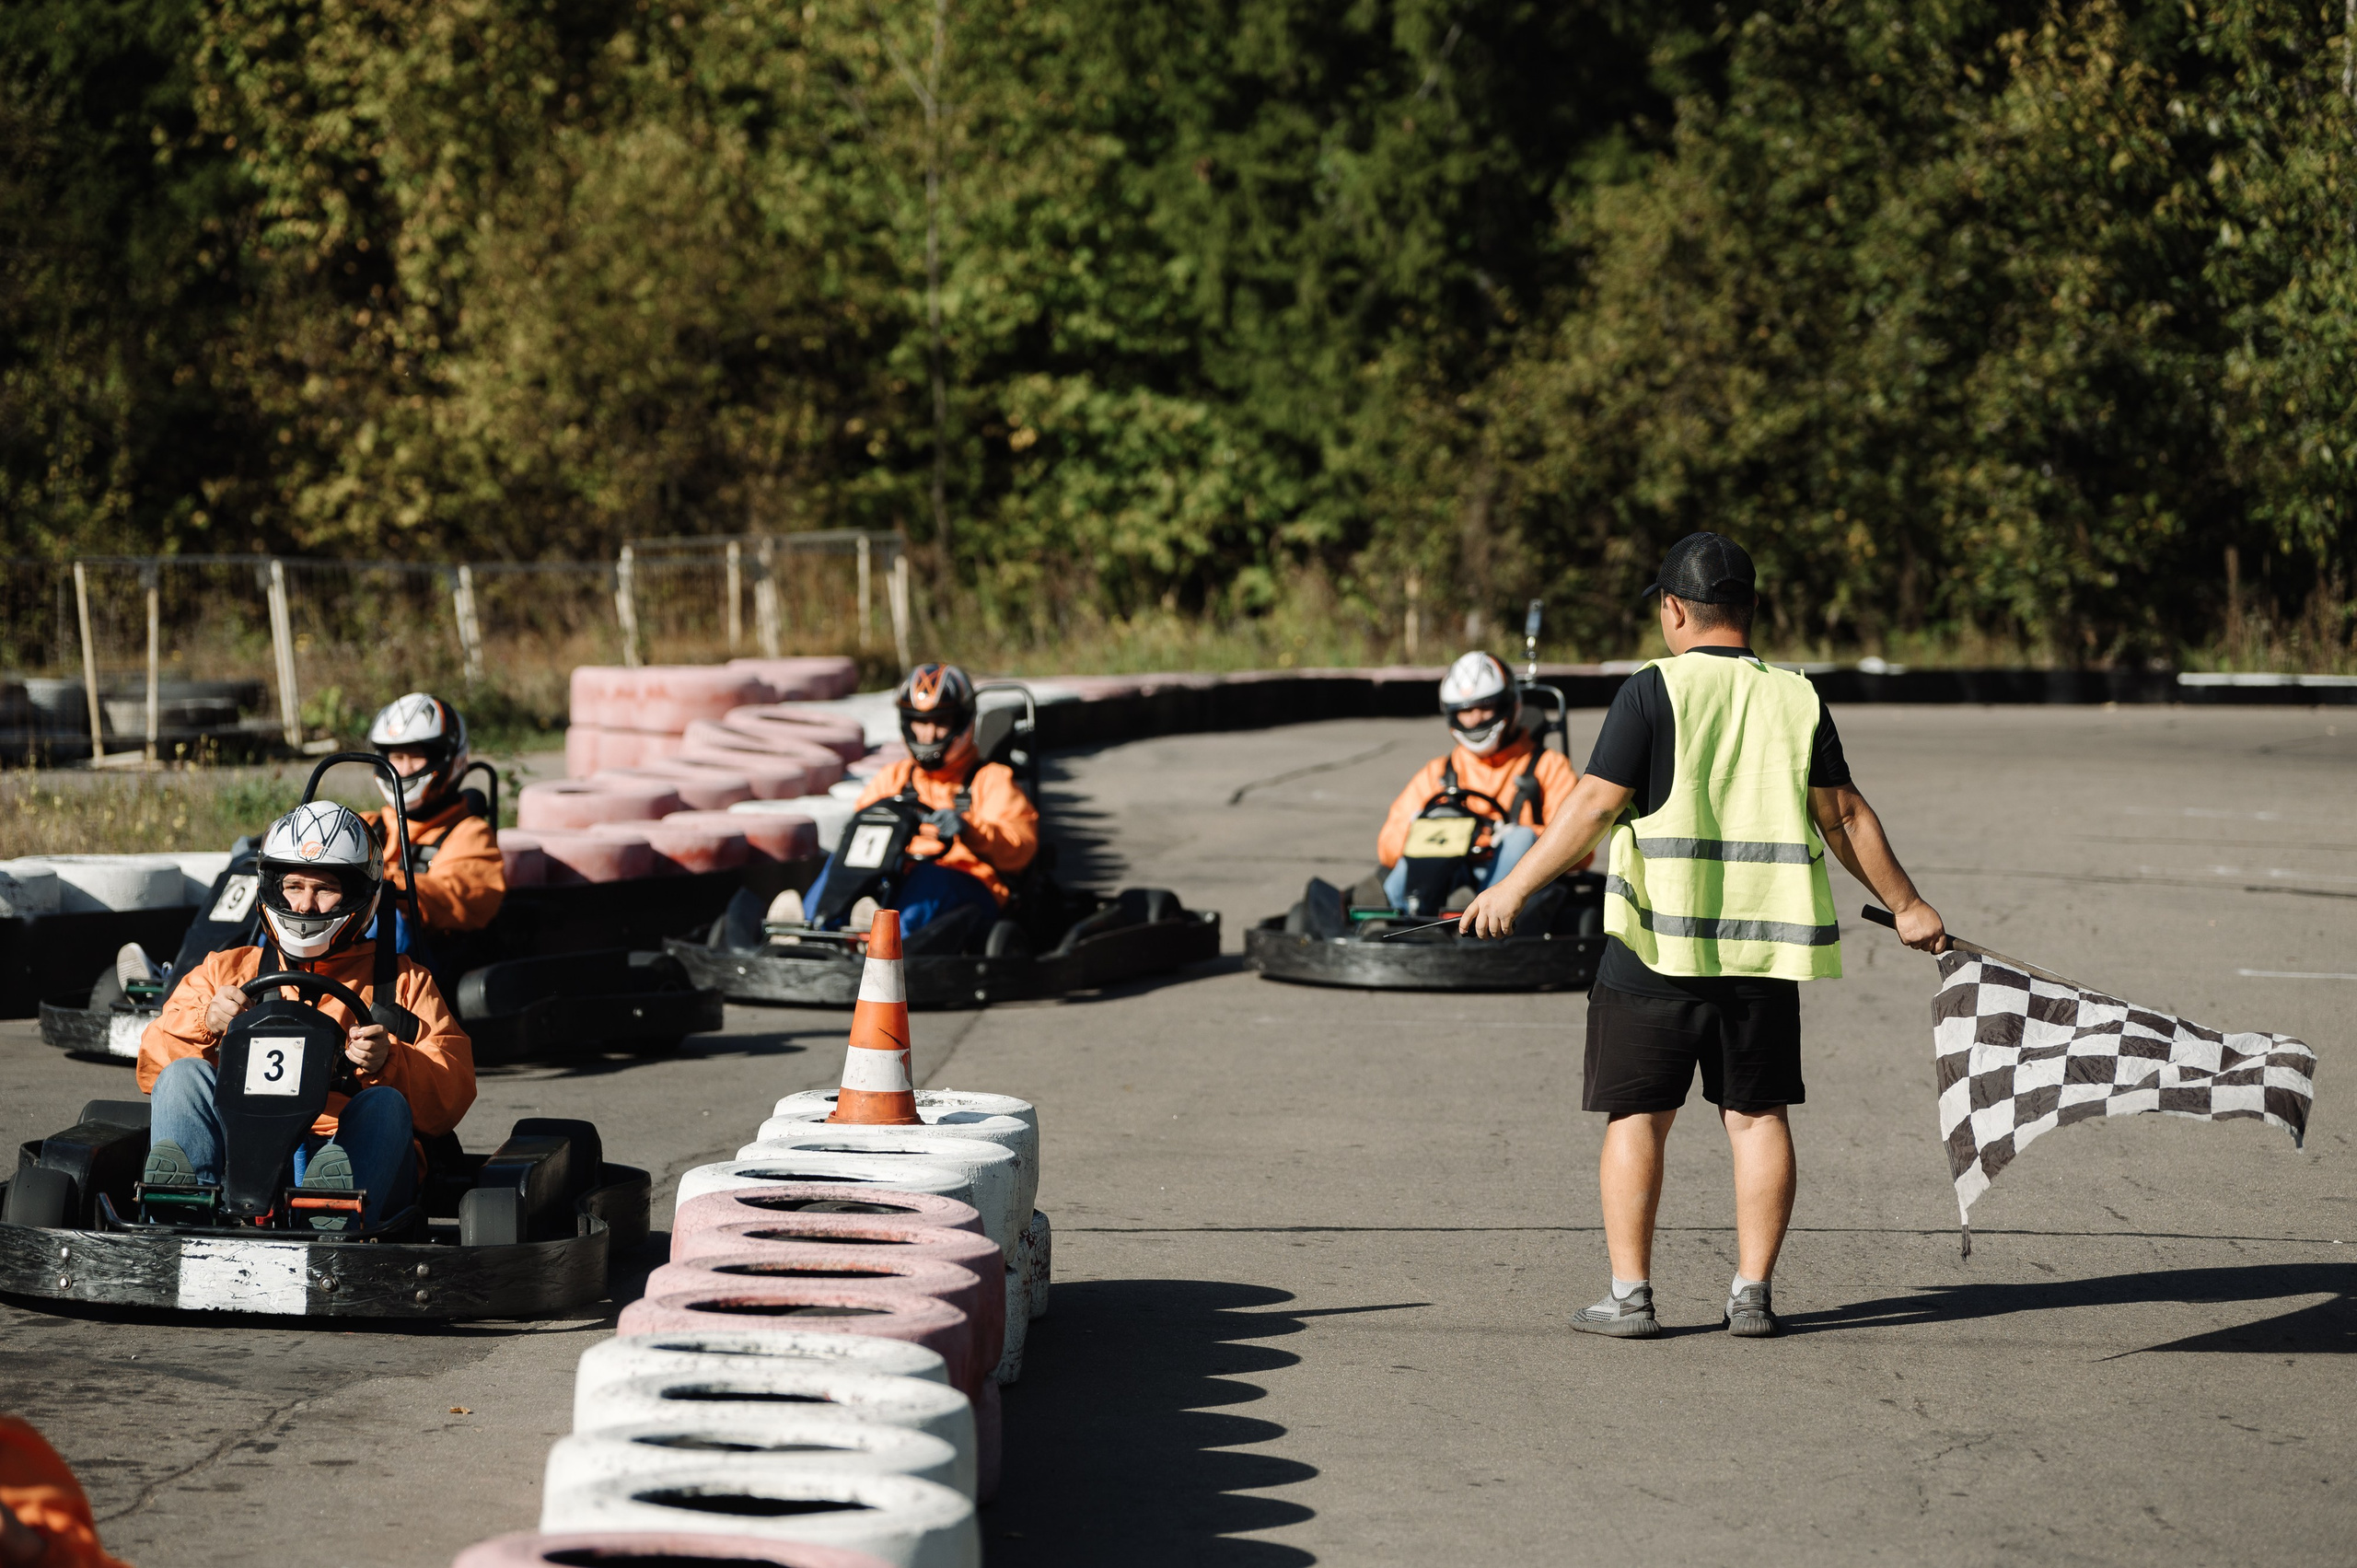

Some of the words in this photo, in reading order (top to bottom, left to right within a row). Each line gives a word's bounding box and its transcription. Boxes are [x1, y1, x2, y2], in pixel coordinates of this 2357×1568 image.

[865, 835, 876, 859] 1
[1424, 828, 1449, 846] 4
[263, 1049, 284, 1082] 3
